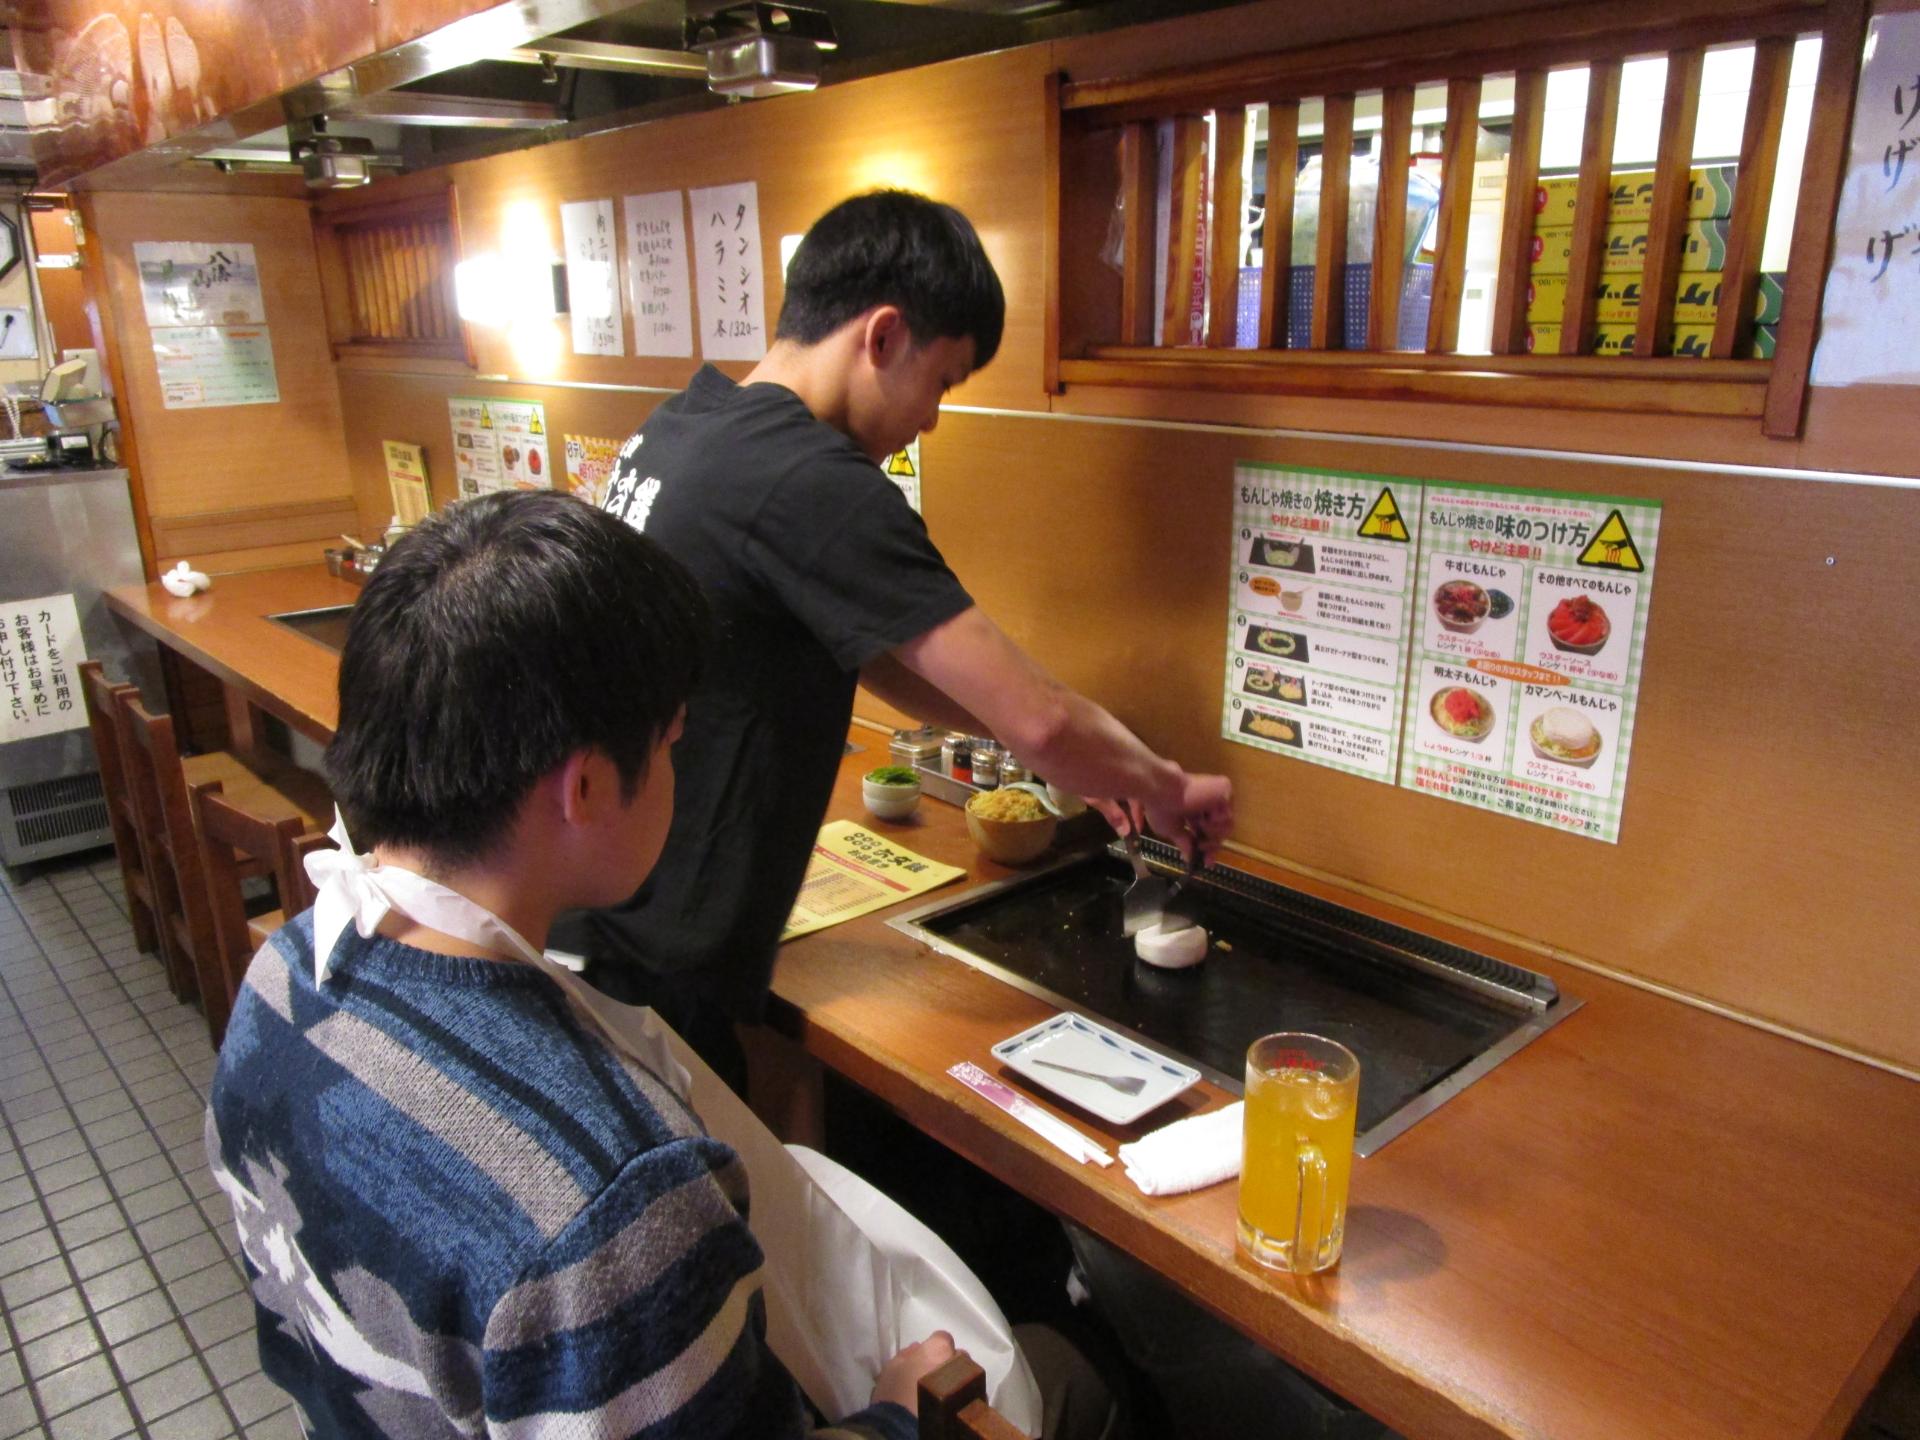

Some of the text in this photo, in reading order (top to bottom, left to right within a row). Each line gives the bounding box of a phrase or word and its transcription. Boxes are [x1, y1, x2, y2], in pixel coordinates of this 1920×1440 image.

[710, 212, 727, 304] ハラミ
[734, 203, 751, 315] タンシオ
[1241, 486, 1366, 520] もんじゃ焼きの焼き方
[1430, 511, 1590, 548] もんじゃ焼きの味のつけ方
[1445, 559, 1506, 578] 牛すじもんじゃ
[1538, 572, 1631, 595] その他すべてのもんじゃ
[1437, 634, 1484, 647] ウスターソース
[15, 614, 50, 717] お客様はお早めに
[38, 610, 73, 711] カードをご利用の
[1539, 652, 1592, 666] ウスターソース
[1434, 666, 1497, 688] 明太子もんじゃ
[1525, 685, 1617, 711] カマンベールもんじゃ
[1527, 760, 1578, 777] ウスターソース
